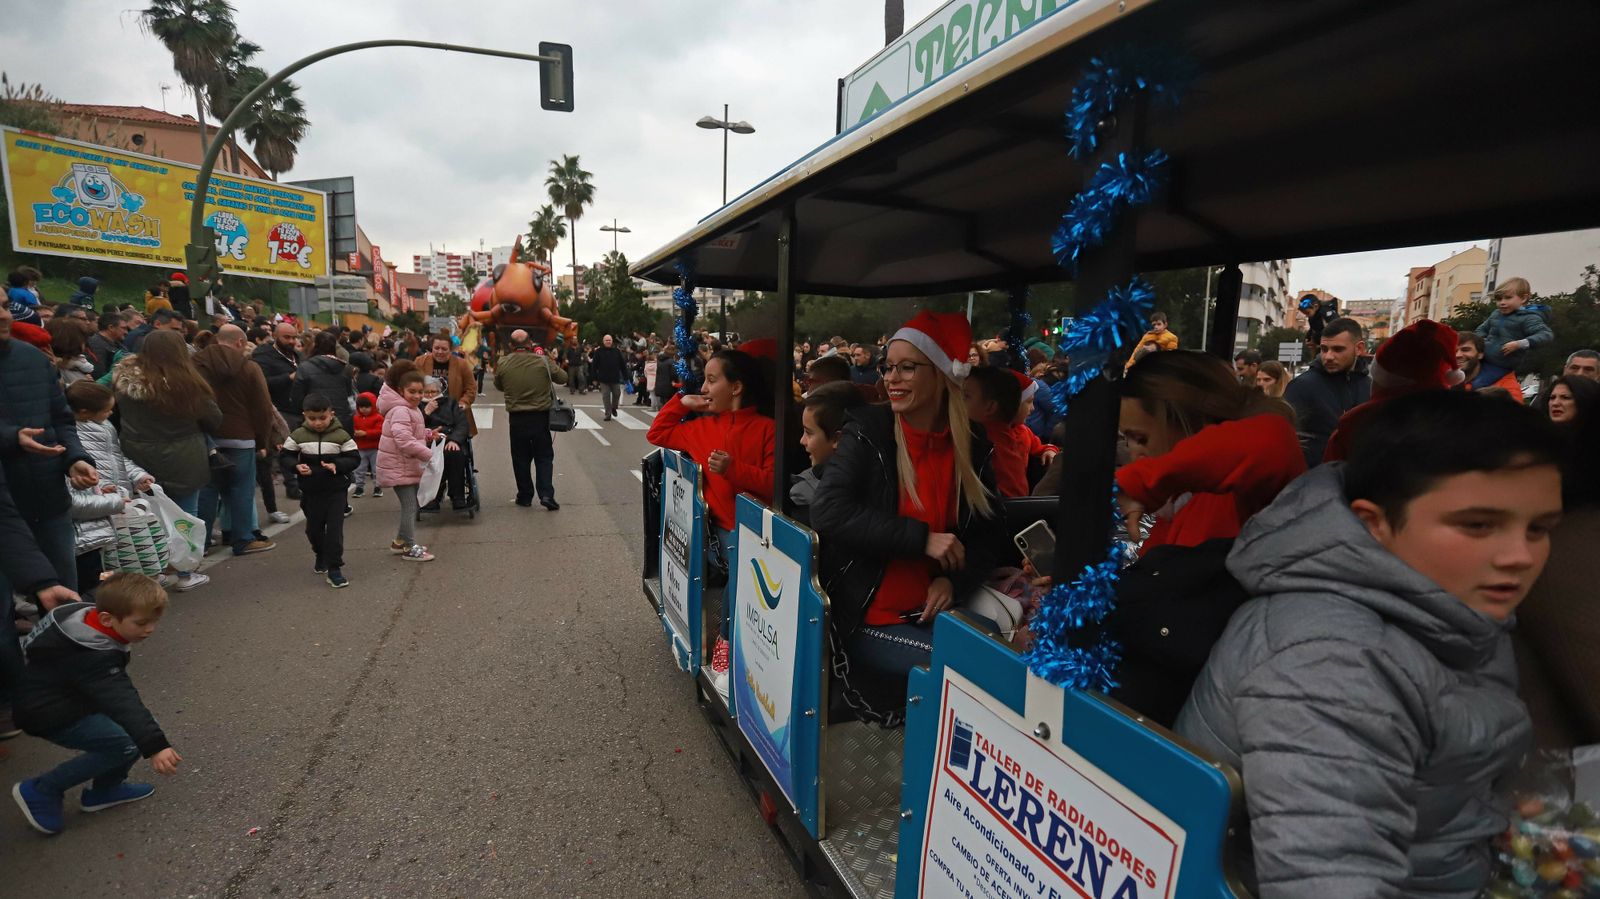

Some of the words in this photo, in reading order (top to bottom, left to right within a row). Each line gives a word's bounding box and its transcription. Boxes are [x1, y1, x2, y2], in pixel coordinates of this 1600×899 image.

[38, 241, 71, 250] PATRIARCA
[746, 602, 779, 660] IMPULSA
[968, 749, 1139, 899] LERENA
[975, 732, 1022, 780] TALLER
[1024, 771, 1044, 797] DE
[1046, 788, 1157, 890] RADIADORES
[944, 788, 962, 811] Aire
[963, 806, 1035, 884] Acondicionado
[1037, 880, 1046, 896] y
[951, 836, 979, 869] CAMBIO
[979, 866, 990, 883] DE
[929, 849, 955, 883] COMPRA
[955, 878, 965, 893] TU
[985, 853, 1012, 887] OFERTA
